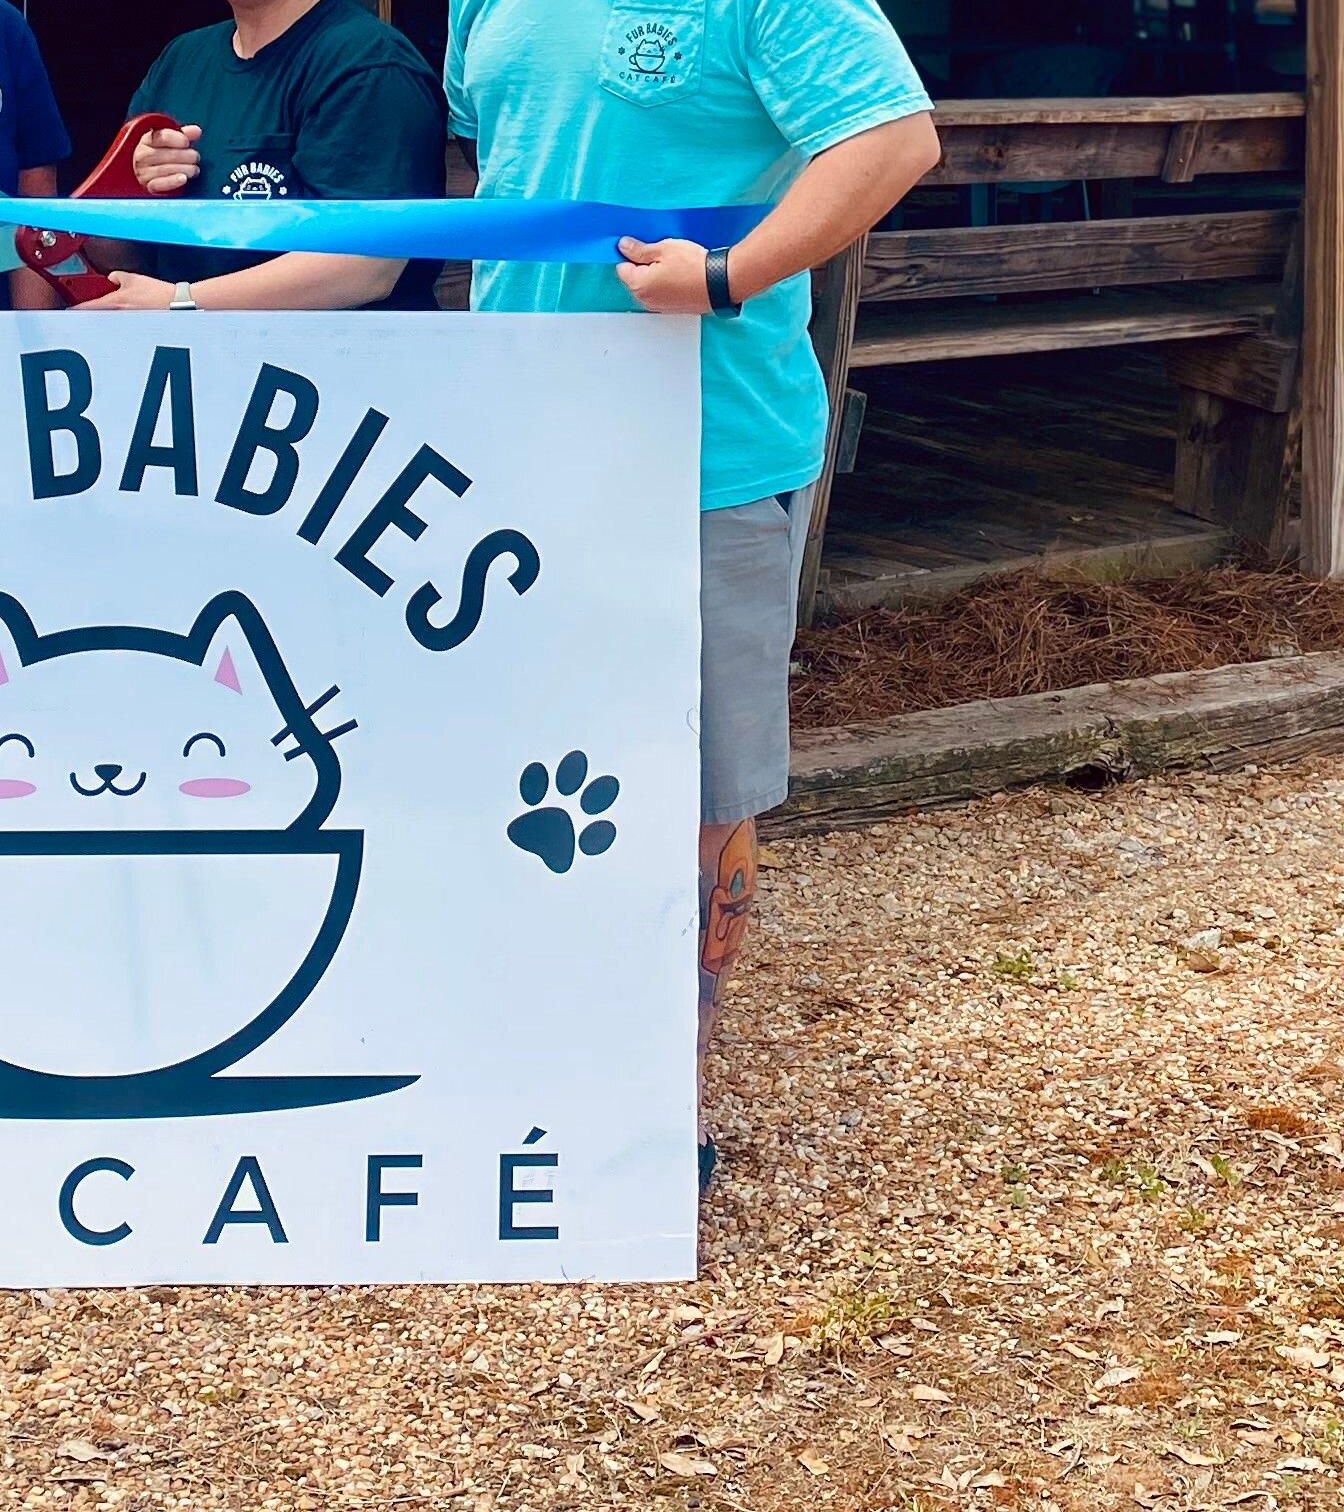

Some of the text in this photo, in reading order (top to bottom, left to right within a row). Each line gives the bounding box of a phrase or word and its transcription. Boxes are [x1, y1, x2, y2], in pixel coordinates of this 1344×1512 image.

[625, 22, 678, 46] FUR BABIES
[618, 71, 642, 82] CAT
[230, 162, 284, 184] FUR BABIES
[20, 346, 541, 652] BABIES
[58, 1125, 560, 1247] CAFÉ
